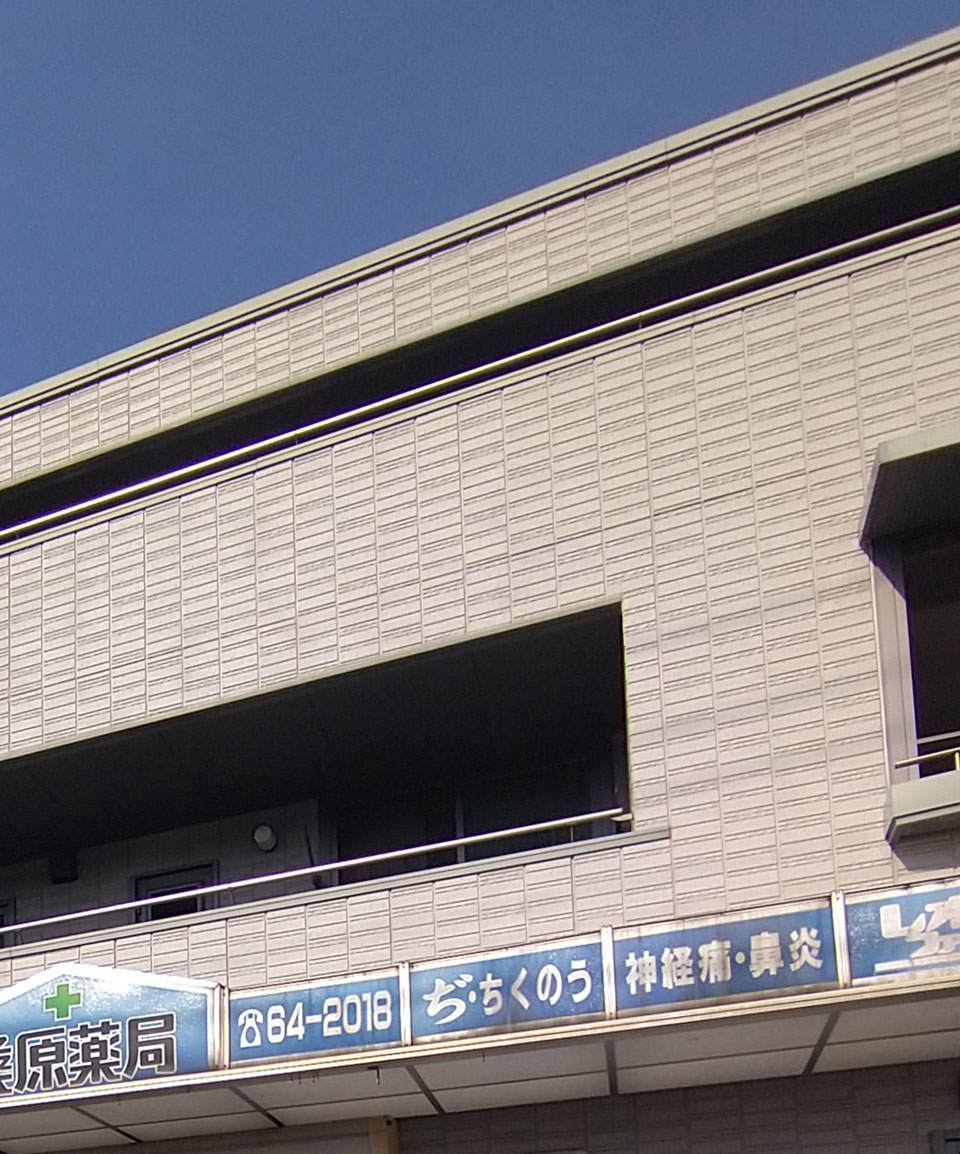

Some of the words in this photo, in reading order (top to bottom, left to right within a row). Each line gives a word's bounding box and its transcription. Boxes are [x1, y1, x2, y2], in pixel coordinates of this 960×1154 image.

[422, 957, 592, 1026] ぢ・ちくのう
[625, 926, 823, 994] 神経痛・鼻炎
